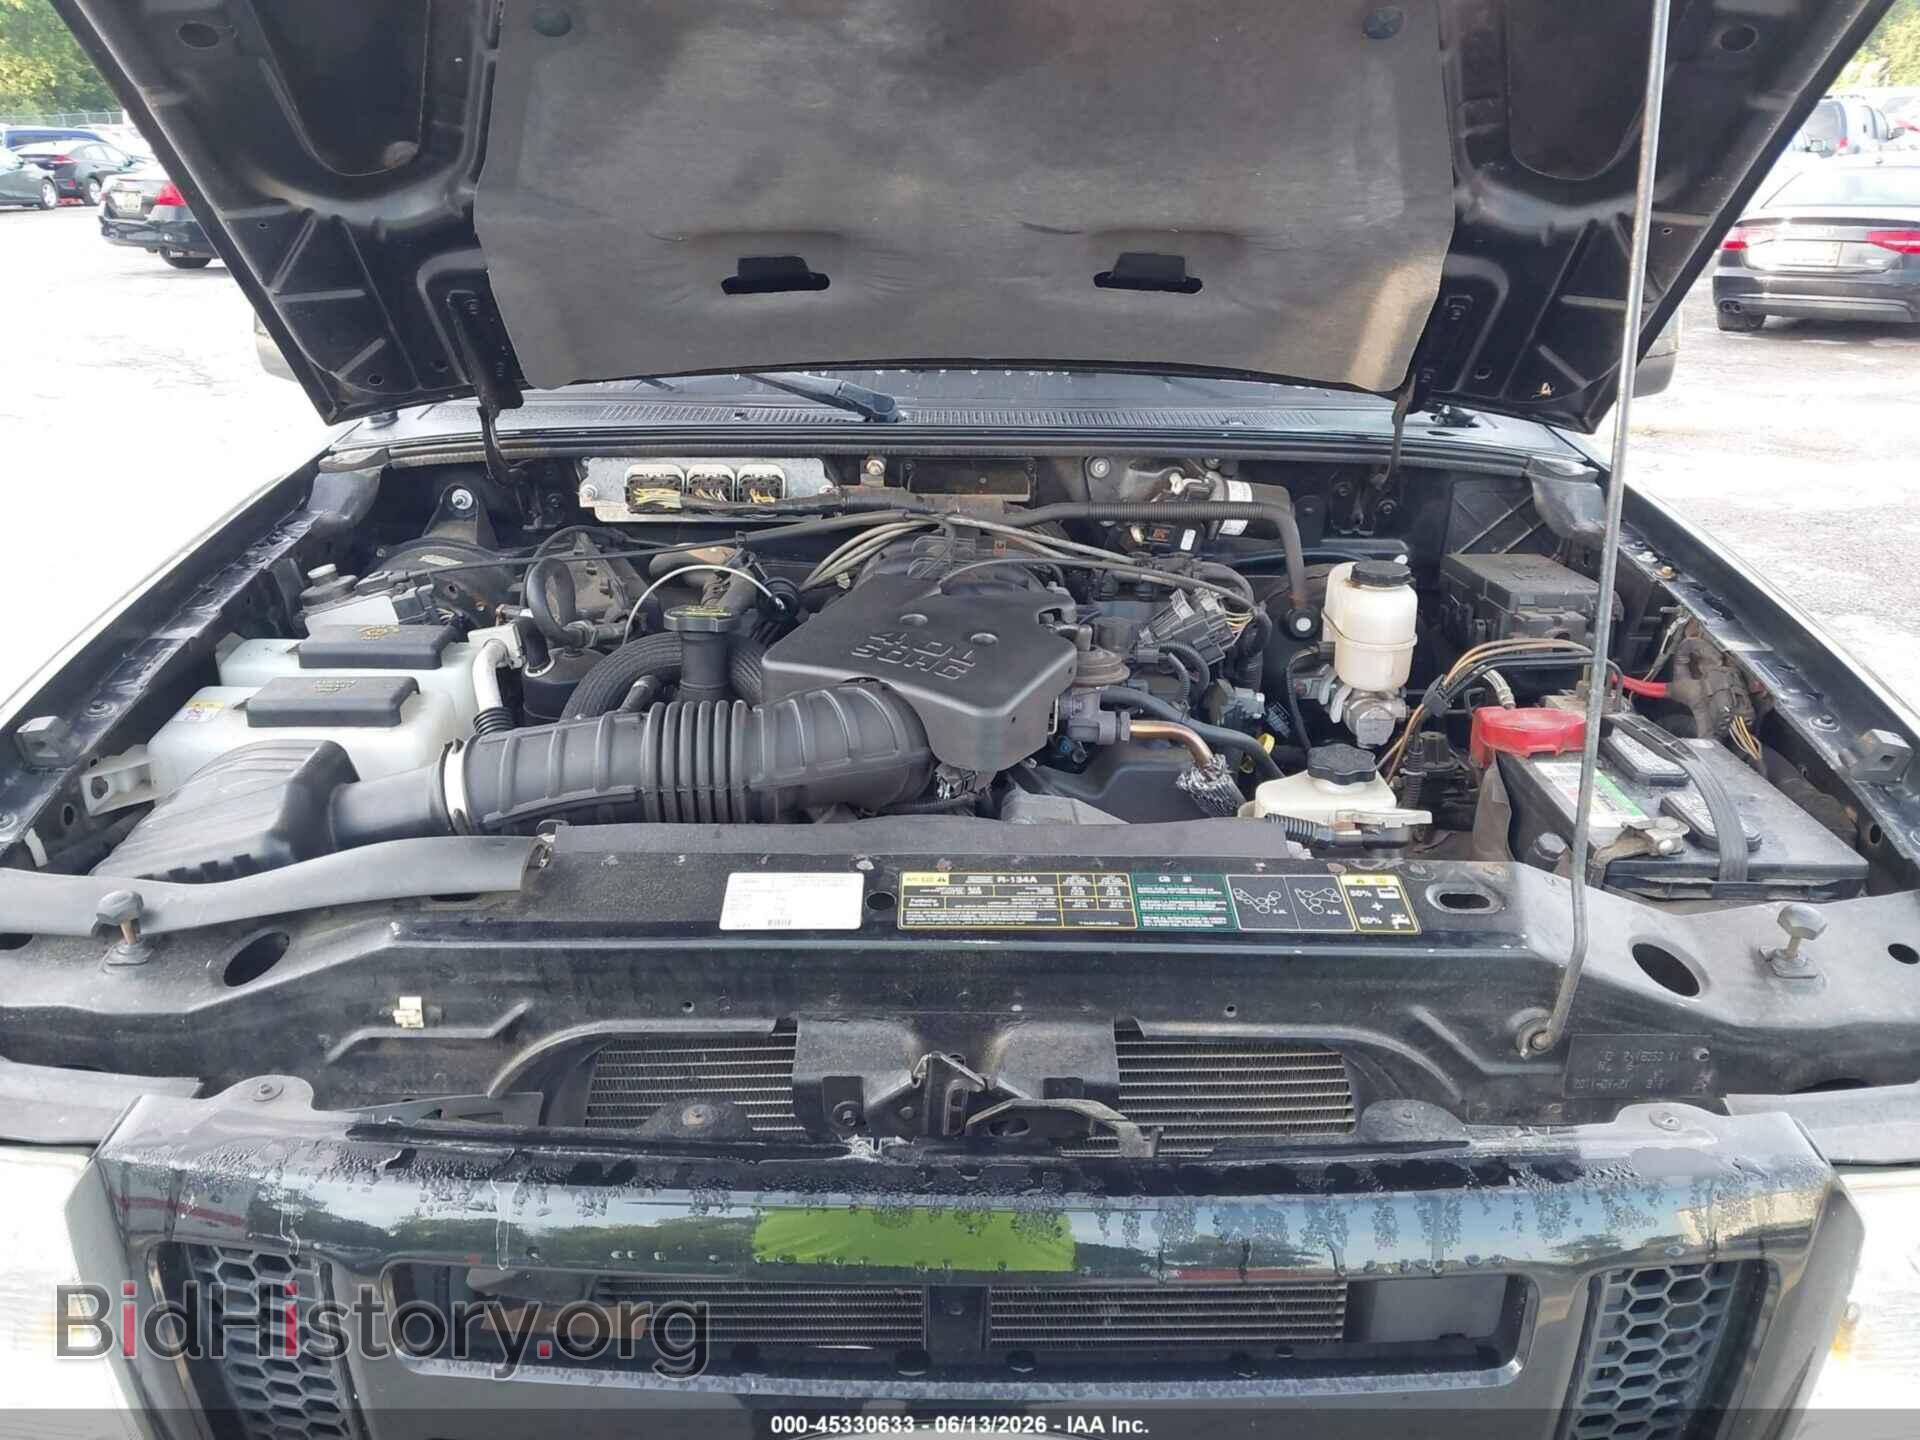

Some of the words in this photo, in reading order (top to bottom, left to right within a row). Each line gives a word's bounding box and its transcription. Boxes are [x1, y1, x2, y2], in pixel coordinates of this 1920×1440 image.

[850, 644, 967, 679] SOHC
[997, 875, 1038, 884] R-134A
[1349, 889, 1372, 897] 50%
[1359, 916, 1383, 924] 50%
